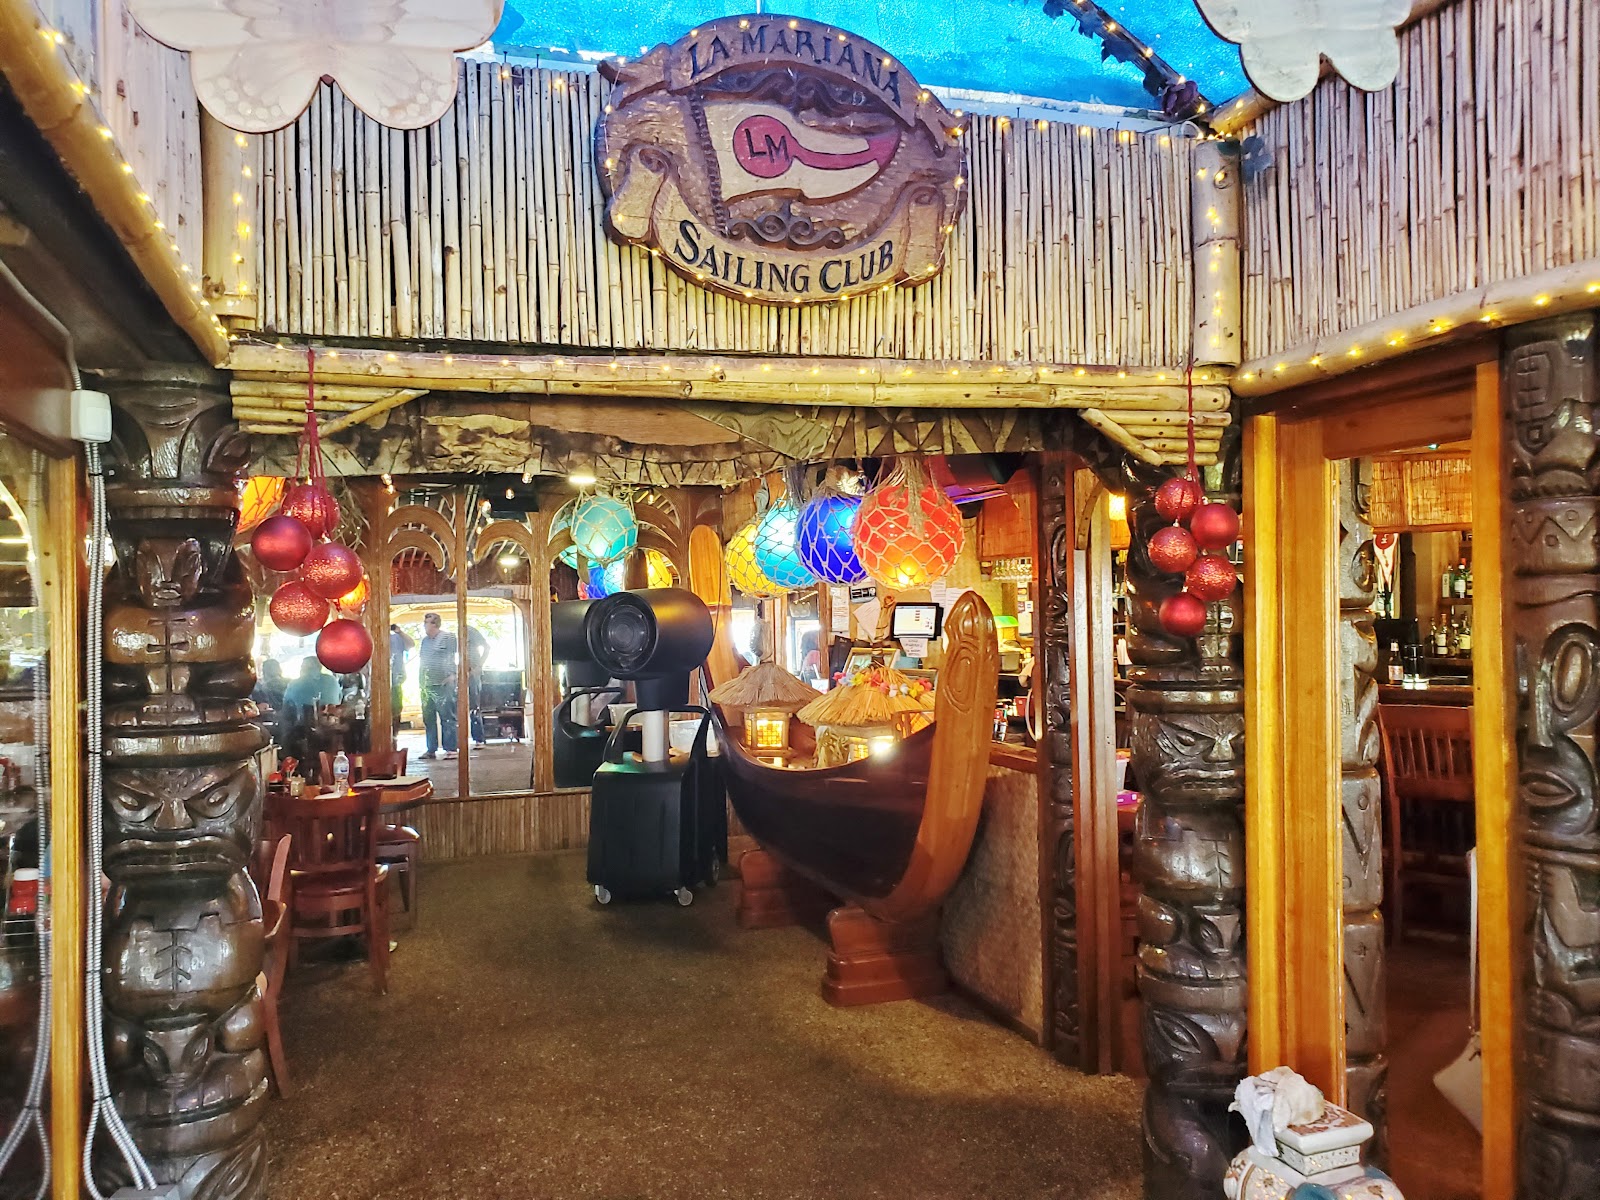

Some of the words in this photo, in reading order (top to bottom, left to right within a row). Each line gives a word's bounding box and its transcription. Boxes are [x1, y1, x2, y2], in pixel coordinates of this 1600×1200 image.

[688, 36, 730, 79] LA
[741, 24, 901, 107] MARIANA
[744, 128, 789, 163] LM
[673, 220, 810, 292] SAILING
[819, 240, 893, 293] CLUB
